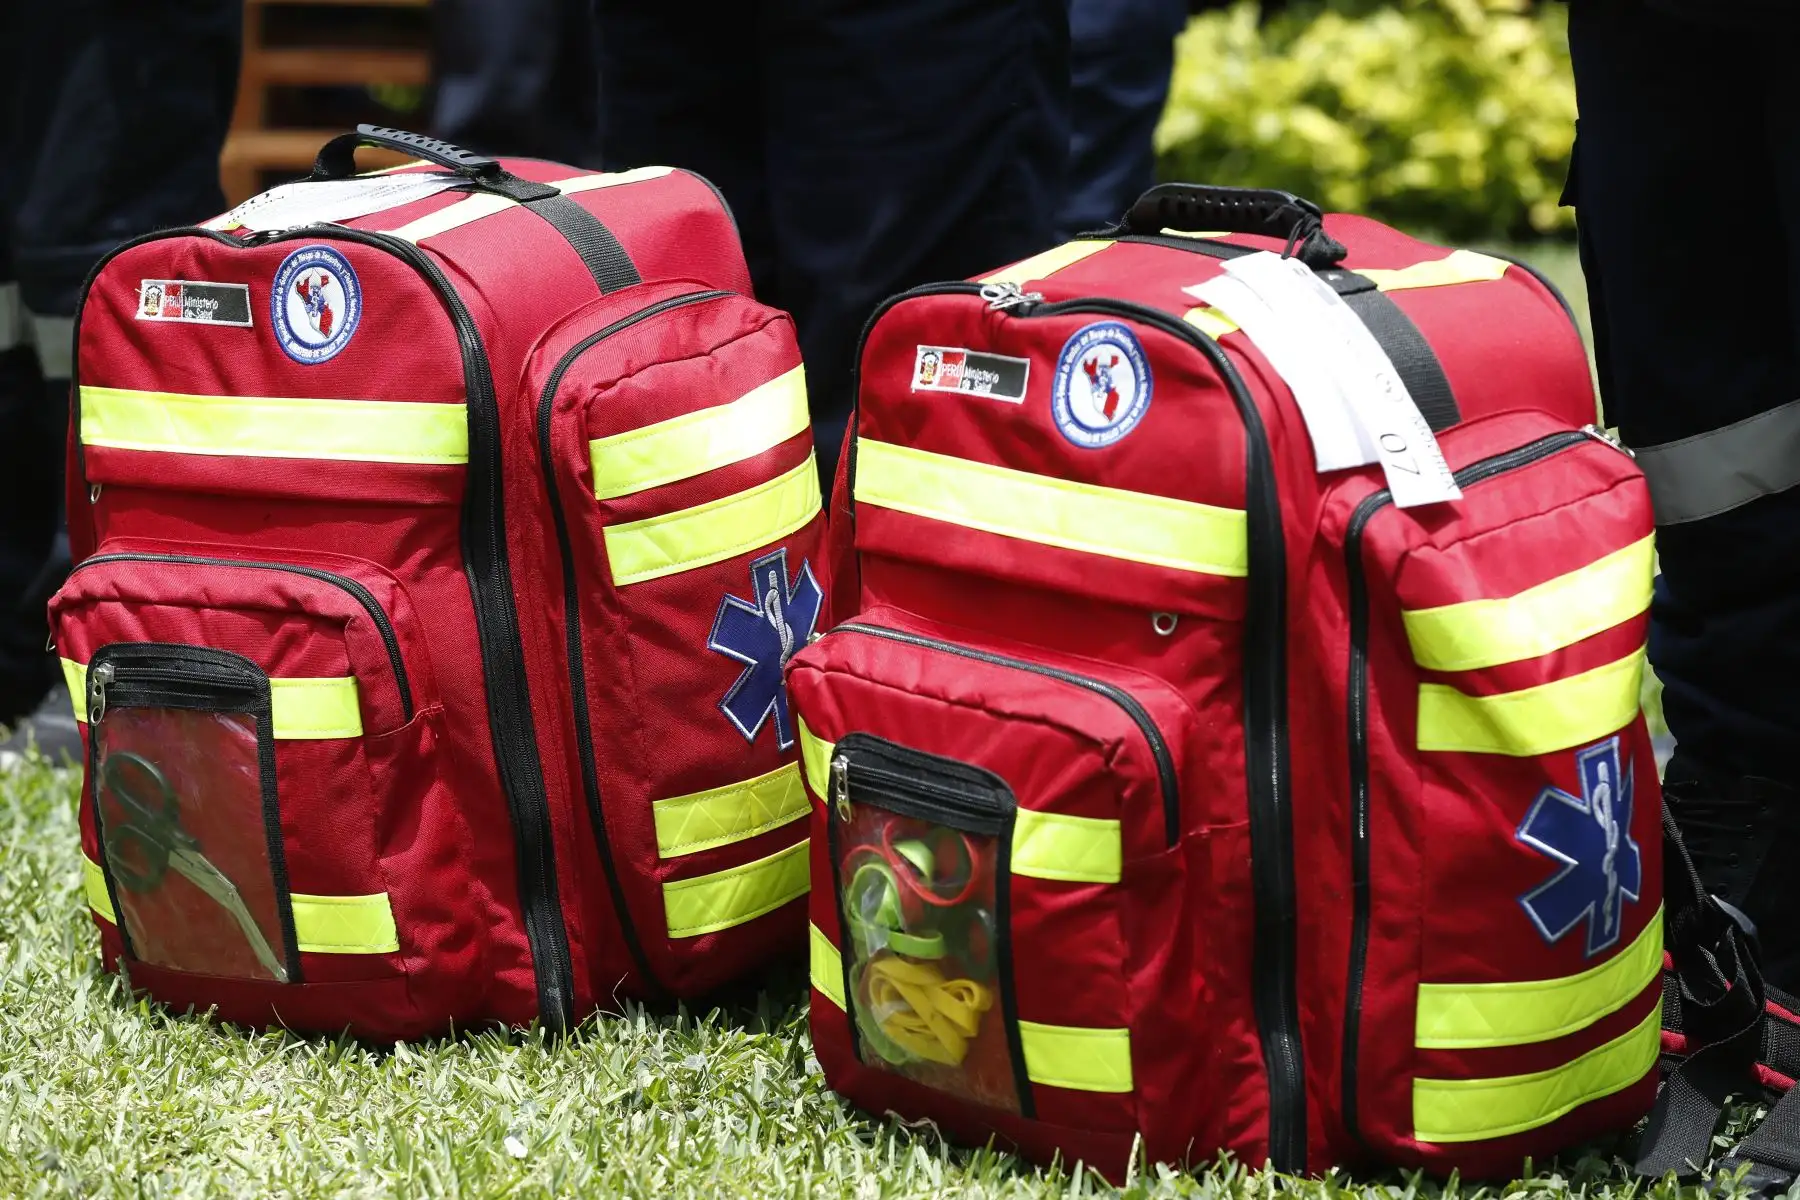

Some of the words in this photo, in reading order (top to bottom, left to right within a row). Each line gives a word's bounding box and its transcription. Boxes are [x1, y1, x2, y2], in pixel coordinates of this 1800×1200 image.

[184, 296, 219, 310] Ministerio
[184, 308, 195, 319] de
[941, 361, 964, 377] PERÚ
[1379, 433, 1421, 475] 07
